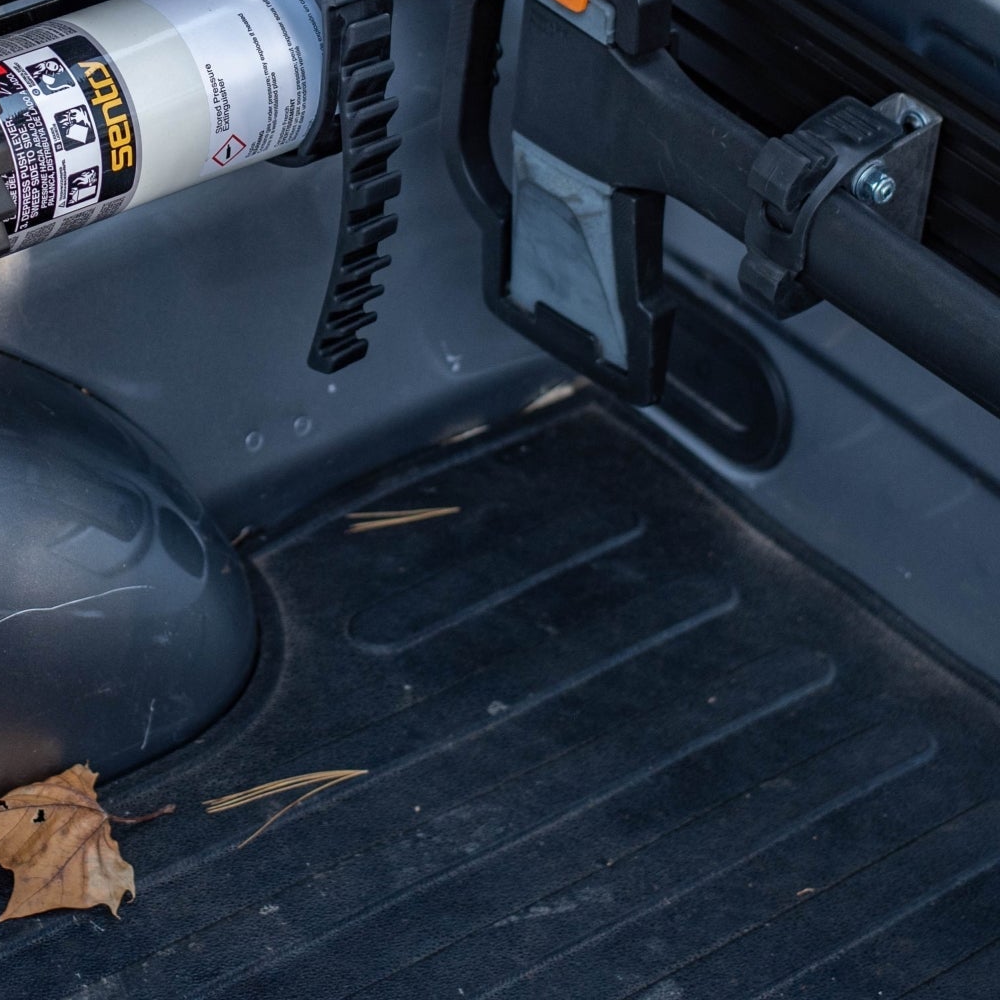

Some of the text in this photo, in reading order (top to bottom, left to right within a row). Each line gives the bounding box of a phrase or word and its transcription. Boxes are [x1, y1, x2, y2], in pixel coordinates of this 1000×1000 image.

[238, 12, 252, 32] heated
[270, 8, 280, 20] sous
[278, 22, 292, 46] exploser
[253, 37, 264, 60] explode
[22, 96, 38, 115] LADO
[205, 63, 222, 134] Stored Pressure
[218, 78, 230, 132] Extinguisher
[23, 112, 32, 122] LA
[33, 116, 42, 126] DE
[78, 61, 133, 172] sentry
[28, 122, 42, 148] ABAJO
[37, 149, 46, 172] HACIA
[38, 128, 54, 171] DISTRIBUYA
[5, 117, 31, 229] 3. DEPRESS PUSH LEVER.
[18, 124, 40, 218] SWEEP SIDE TO SIDE.
